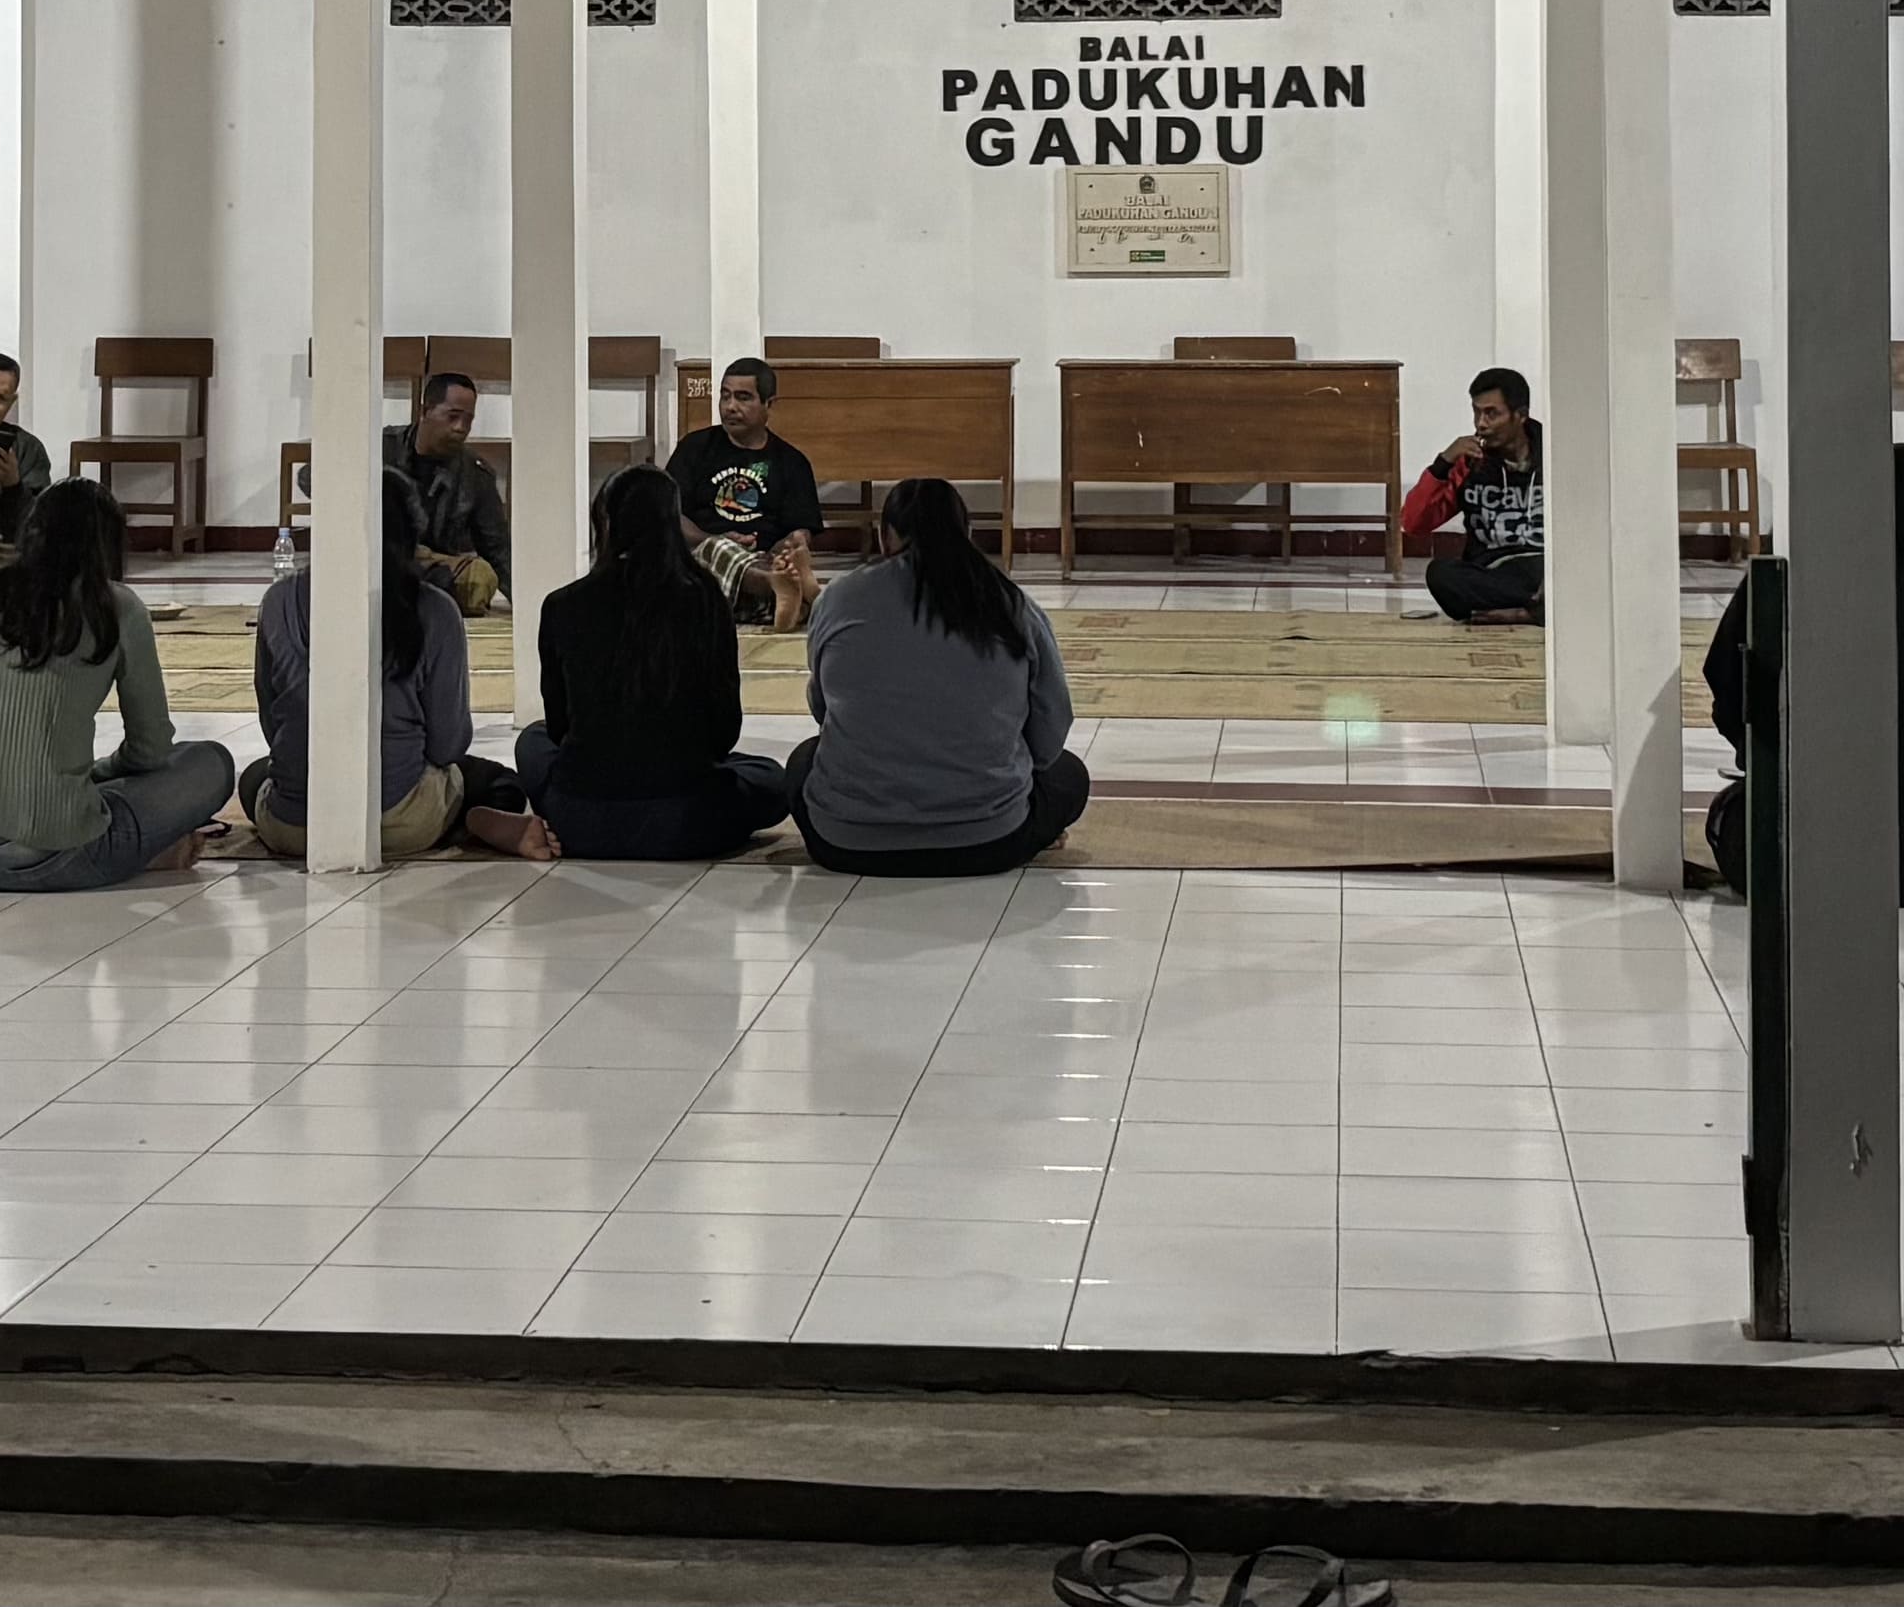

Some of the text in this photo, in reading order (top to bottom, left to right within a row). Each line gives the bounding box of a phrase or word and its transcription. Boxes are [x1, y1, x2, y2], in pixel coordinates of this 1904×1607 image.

[1079, 35, 1205, 62] BALAI
[942, 65, 1365, 112] PADUKUHAN
[965, 115, 1264, 166] GANDU
